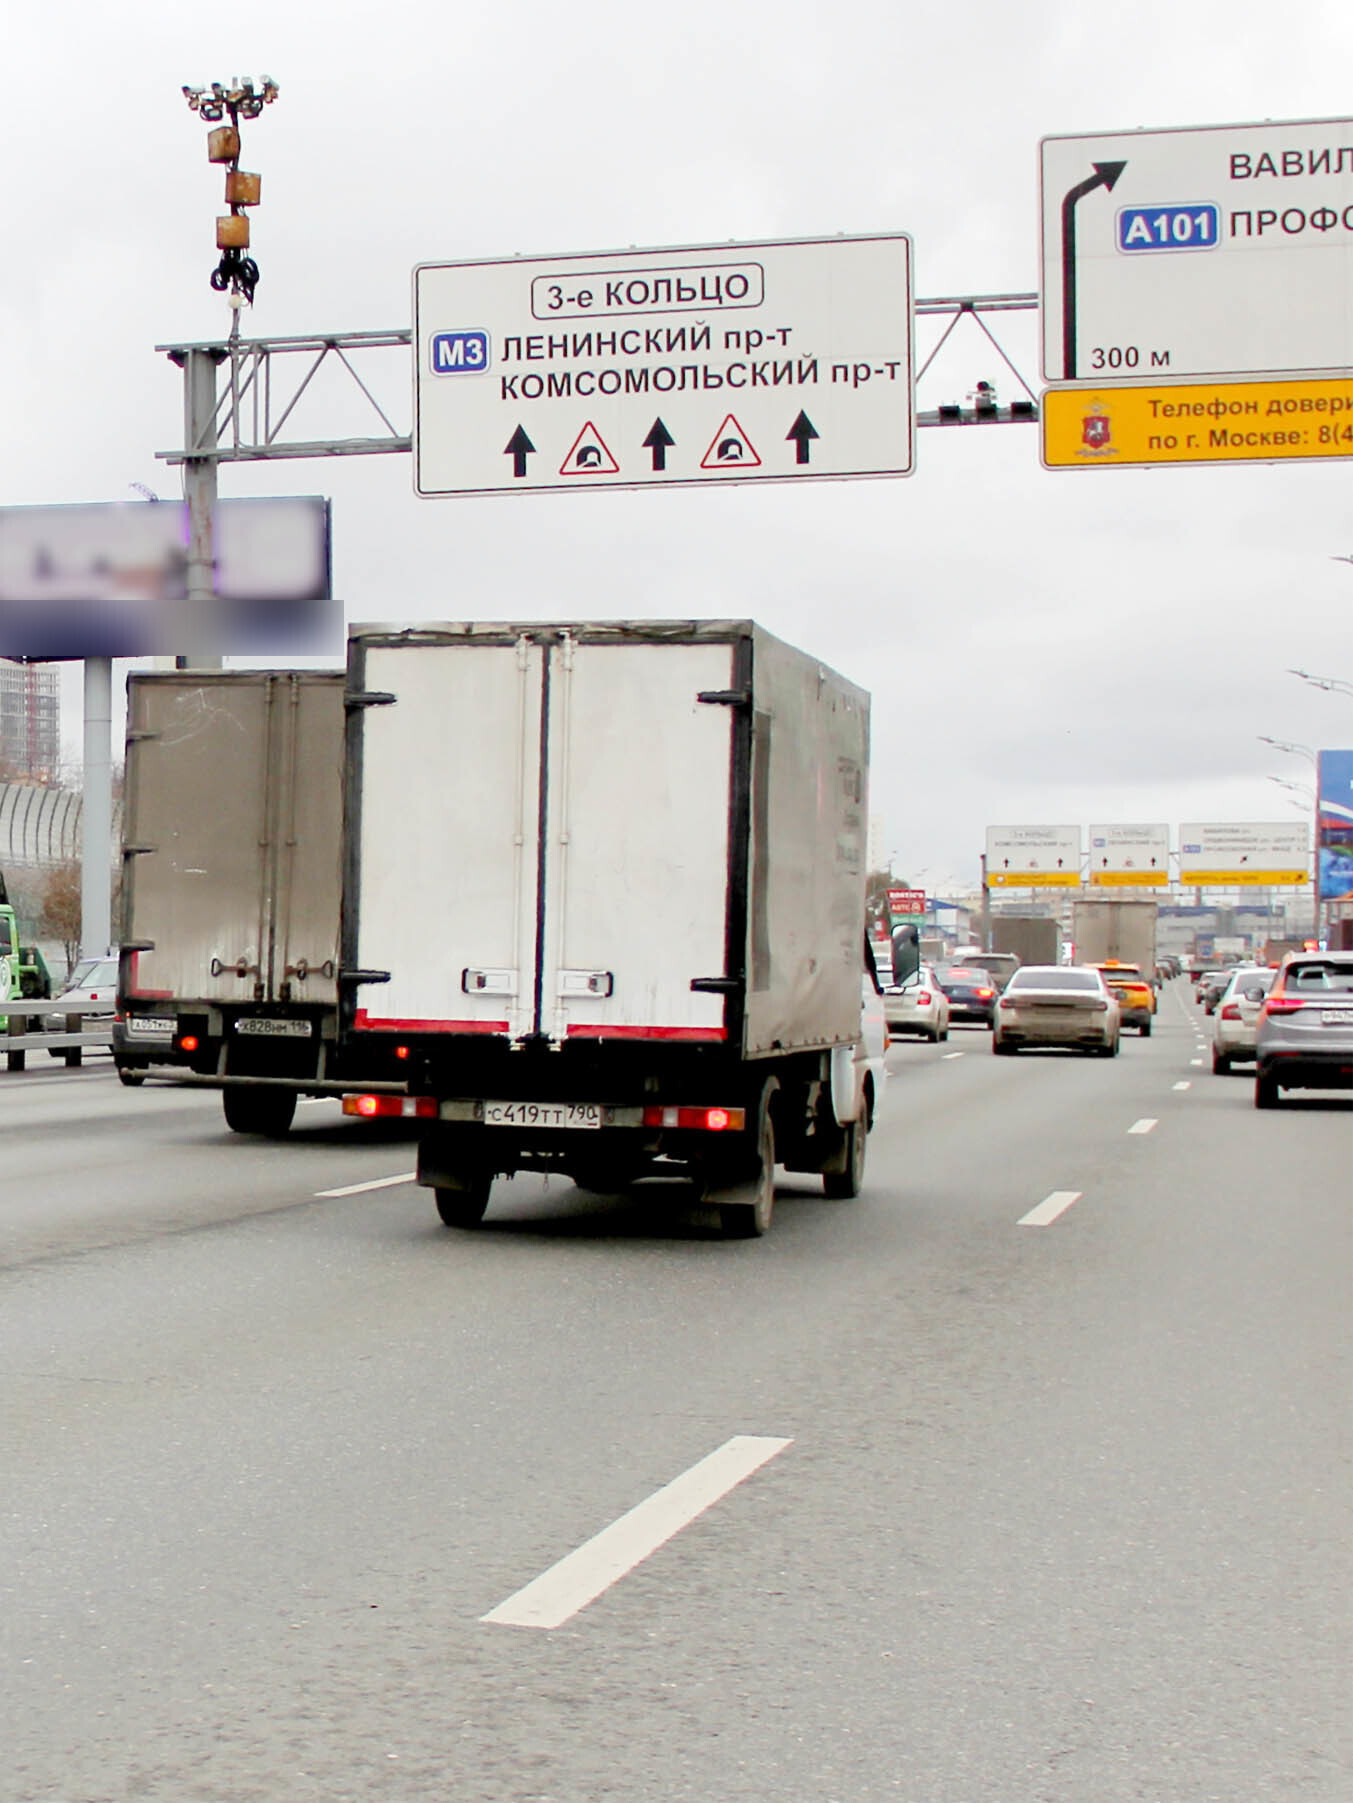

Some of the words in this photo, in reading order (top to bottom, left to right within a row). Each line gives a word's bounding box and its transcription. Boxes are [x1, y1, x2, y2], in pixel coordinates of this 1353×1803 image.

[548, 286, 593, 309] 3-е
[606, 272, 749, 306] КОЛЬЦО
[439, 338, 483, 366] М3
[501, 319, 711, 362] ЛЕНИНСКИЙ
[724, 328, 793, 354] пр-т
[1091, 347, 1139, 369] 300
[1151, 351, 1170, 367] м
[501, 352, 819, 400] КОМСОМОЛЬСКИЙ
[832, 361, 902, 388] пр-т
[1148, 398, 1259, 420] Телефон
[1148, 435, 1179, 449] по
[1186, 433, 1199, 448] г.
[1209, 426, 1310, 448] Москве:
